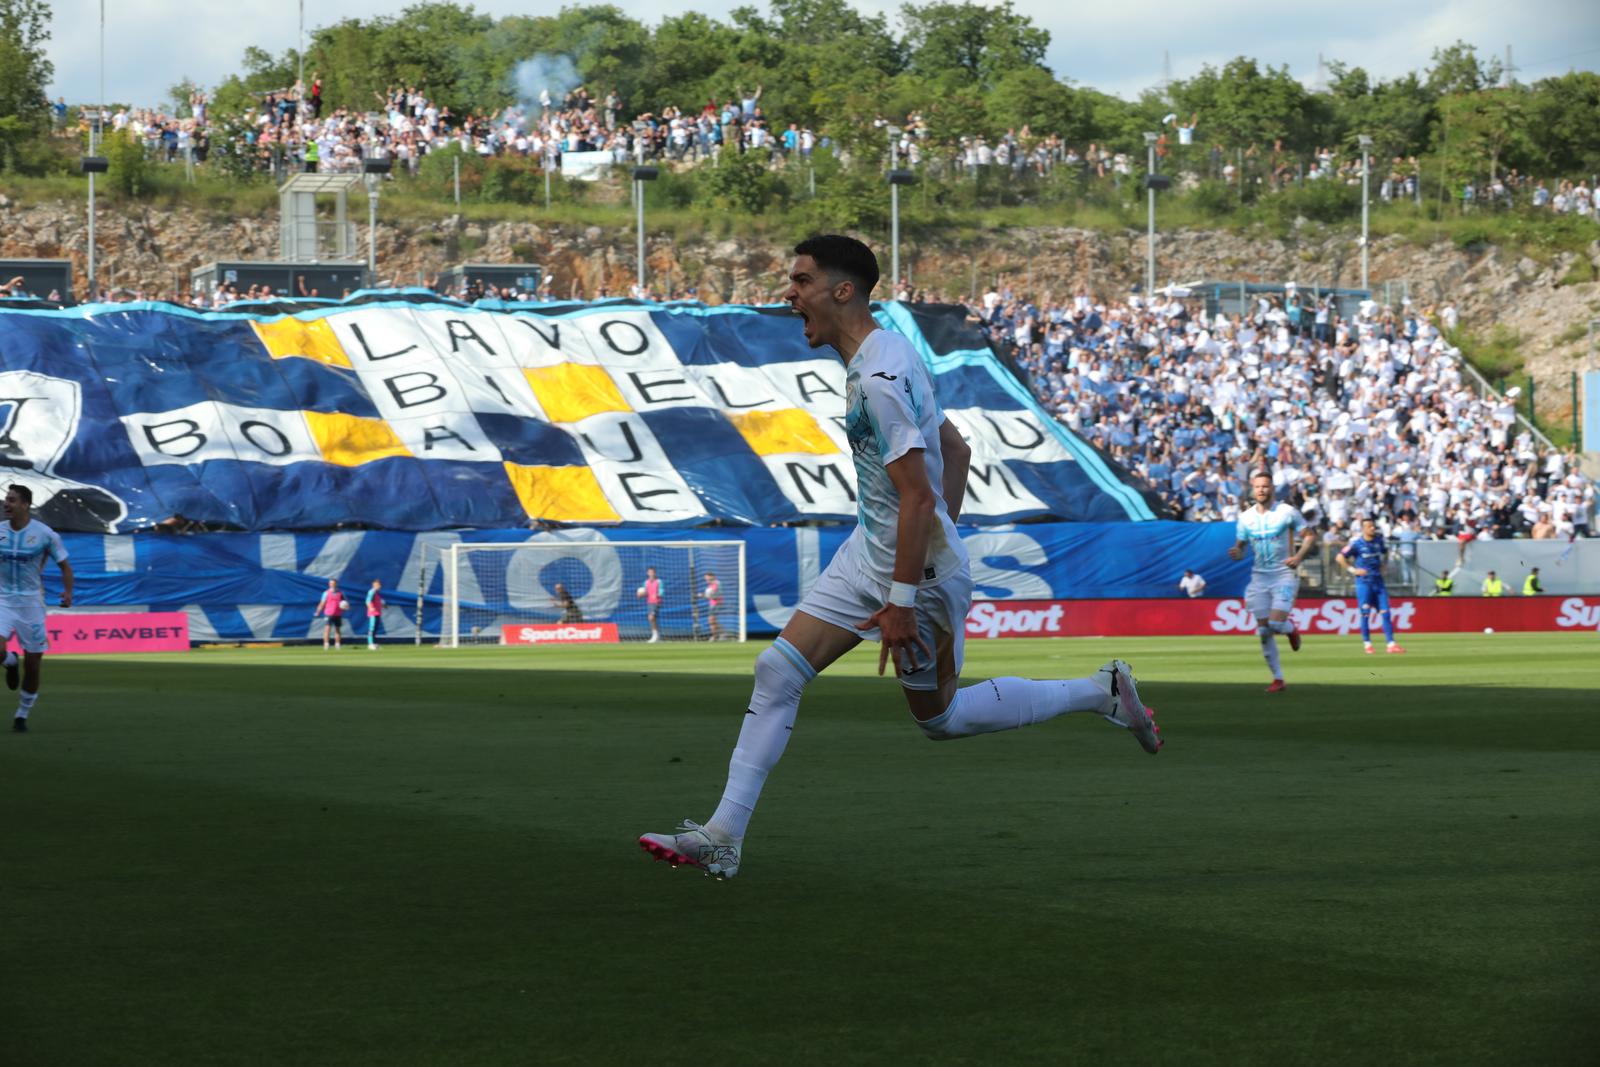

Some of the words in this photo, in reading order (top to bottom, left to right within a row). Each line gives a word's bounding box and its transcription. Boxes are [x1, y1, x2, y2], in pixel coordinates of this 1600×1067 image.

[350, 319, 649, 361] LAVO
[142, 419, 292, 457] BO
[424, 425, 477, 452] A
[94, 626, 183, 640] FAVBET
[518, 626, 603, 643] SportCard
[965, 602, 1065, 638] Sport
[1555, 597, 1600, 632] Su
